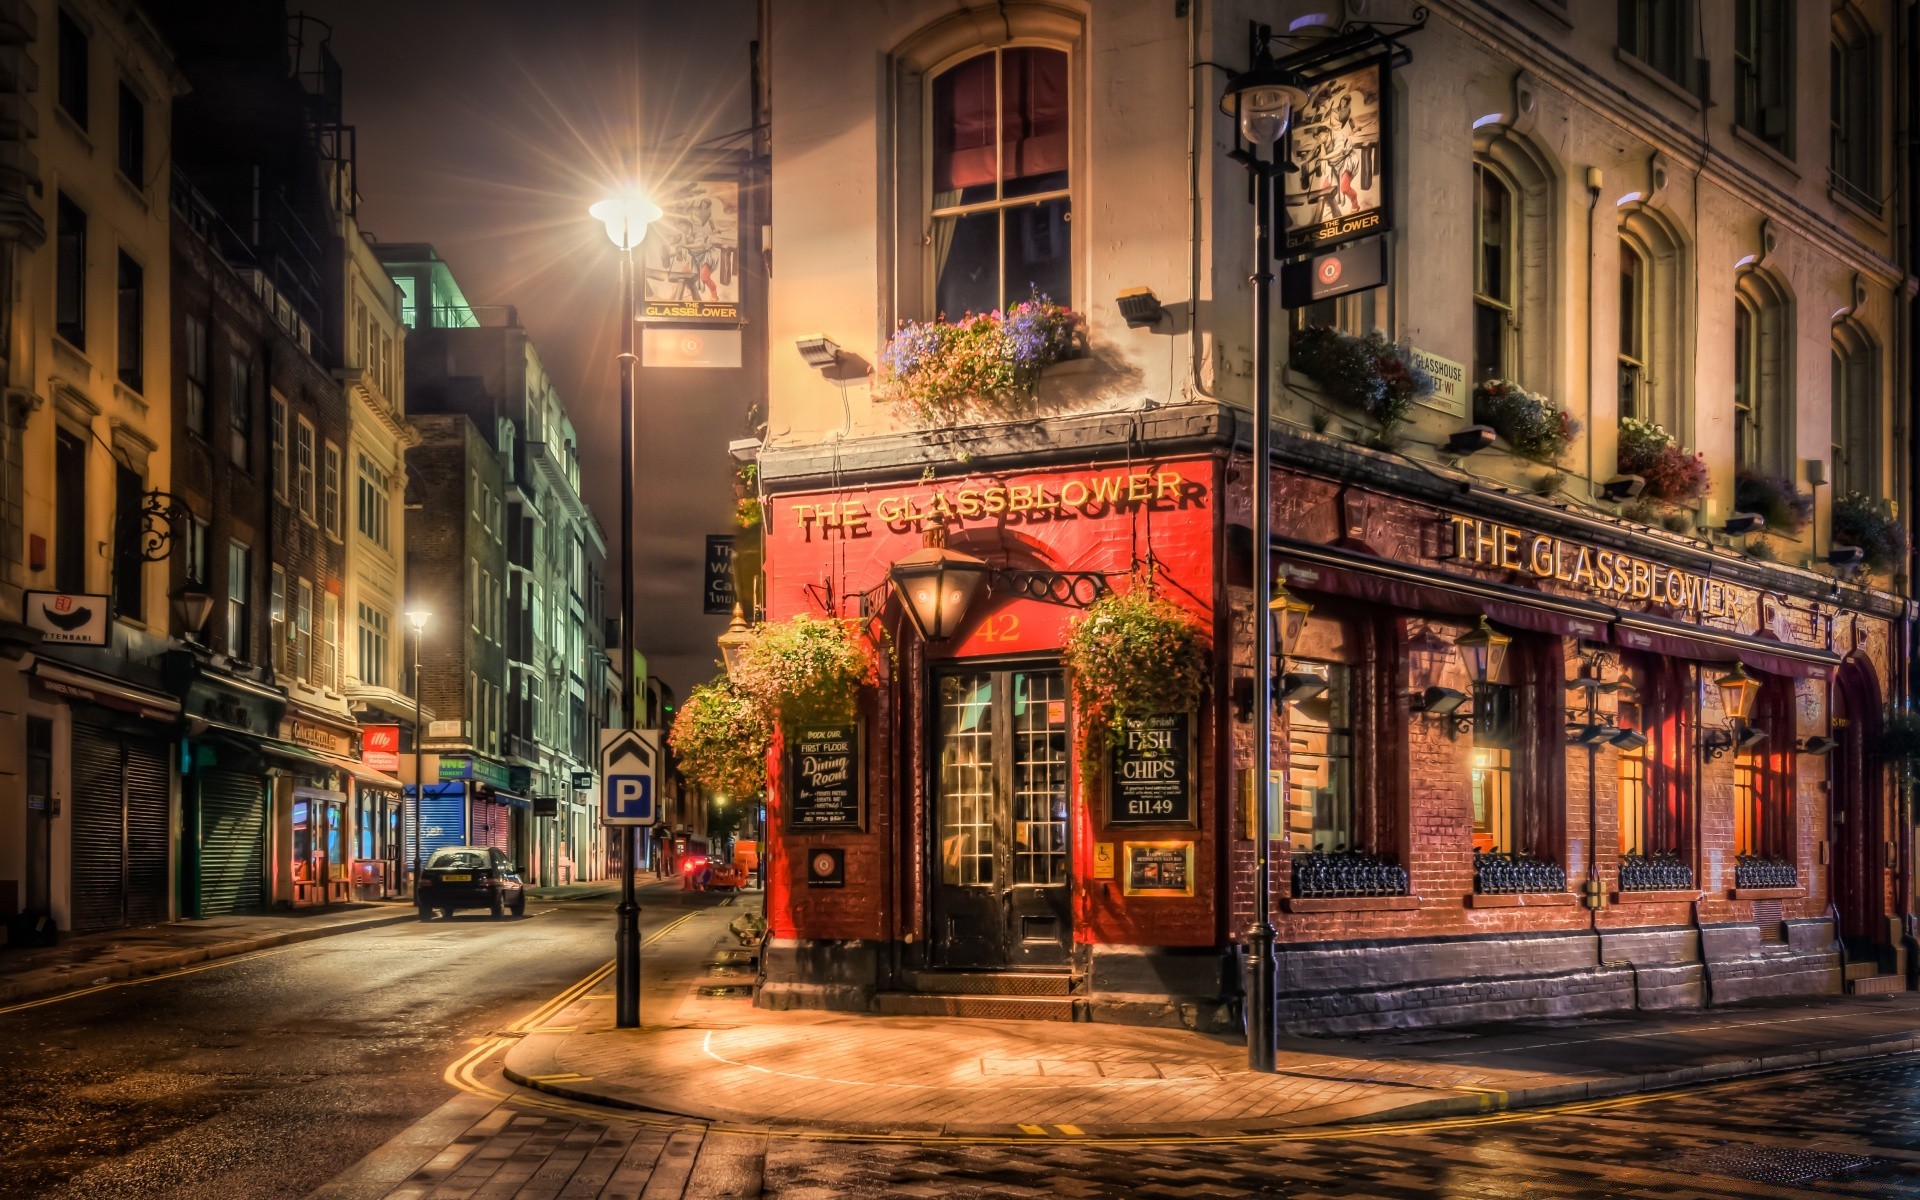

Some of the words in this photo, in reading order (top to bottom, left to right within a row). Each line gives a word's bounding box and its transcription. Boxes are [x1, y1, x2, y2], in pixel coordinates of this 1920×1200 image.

[1286, 214, 1380, 249] GLASSBLOWER
[1324, 218, 1340, 229] THE
[646, 307, 737, 318] GLASSBLOWER
[1414, 354, 1462, 382] GLASSHOUSE
[792, 500, 867, 529] THE
[877, 473, 1184, 523] GLASSBLOWER
[714, 545, 735, 556] Th
[1451, 514, 1522, 571] THE
[1530, 534, 1740, 620] GLASSBLOWER
[712, 579, 735, 591] Ca
[975, 613, 1020, 643] 42
[44, 633, 91, 642] TTENBARI
[371, 732, 390, 748] illy
[801, 744, 821, 753] FIRST
[823, 743, 849, 752] FLOOR
[802, 756, 850, 777] Dining
[1122, 760, 1175, 779] CHIPS
[812, 769, 849, 787] Room
[617, 779, 643, 813] P
[1128, 800, 1173, 815] £11.49
